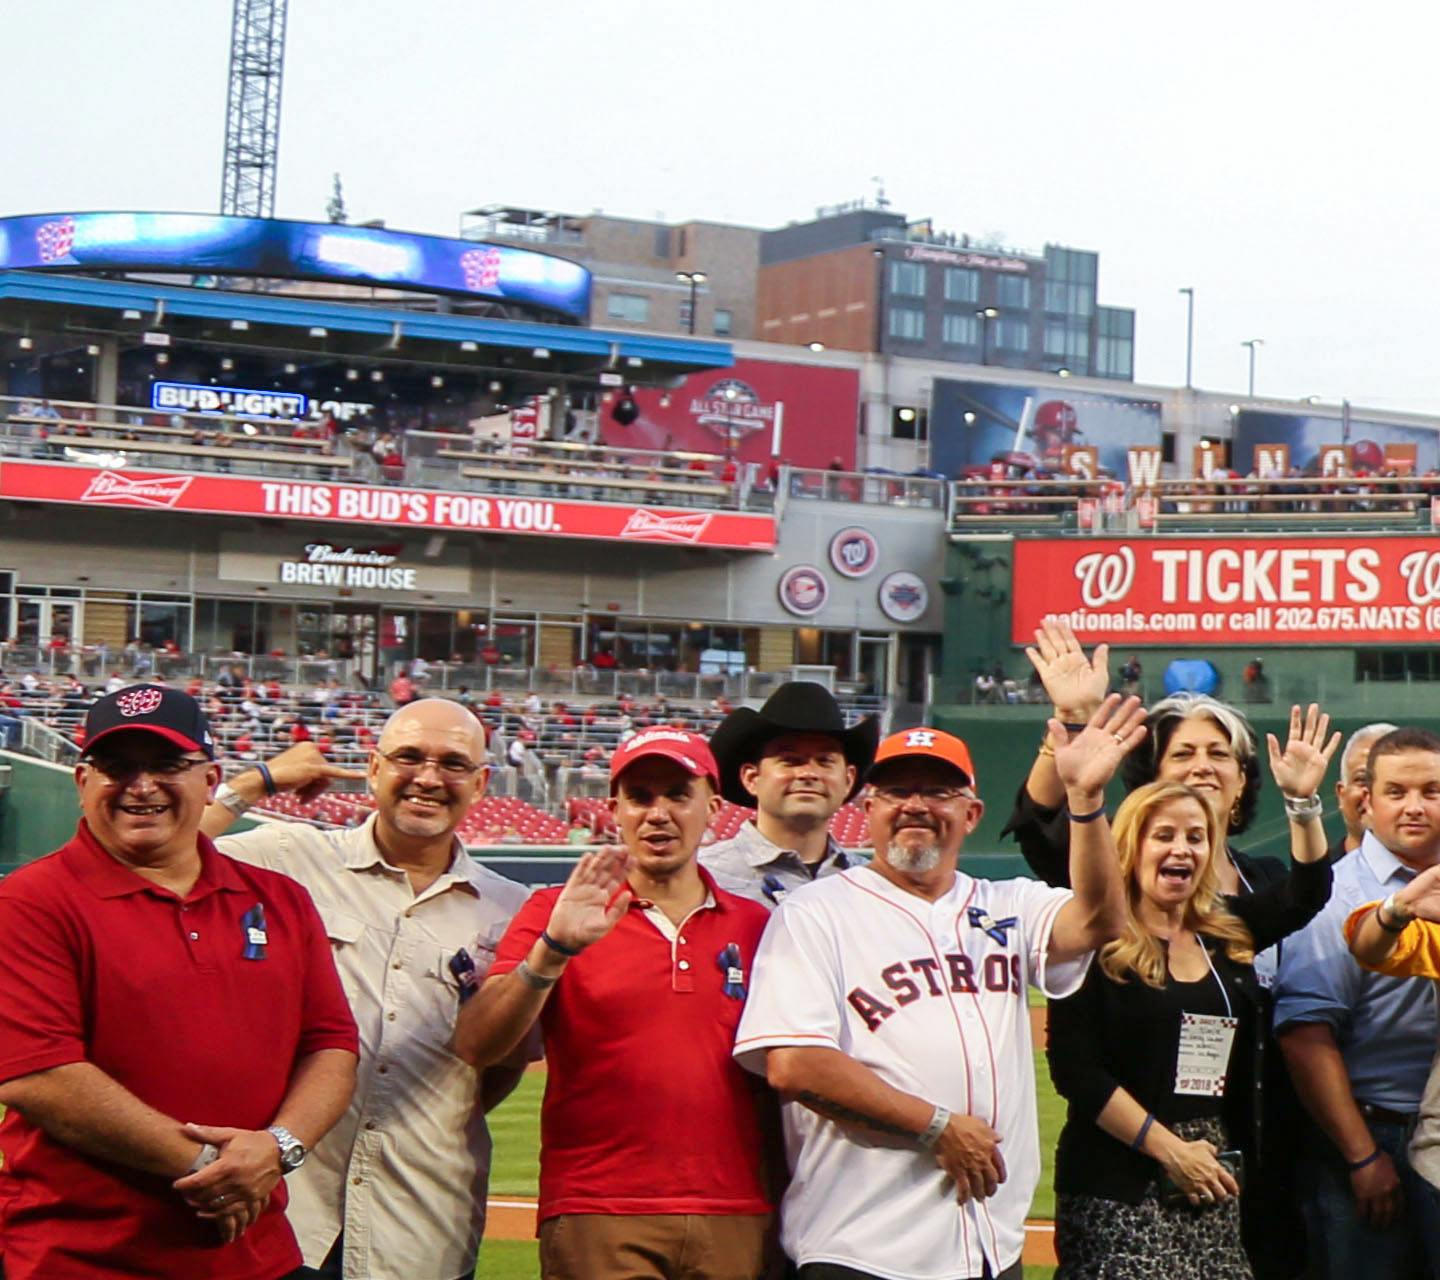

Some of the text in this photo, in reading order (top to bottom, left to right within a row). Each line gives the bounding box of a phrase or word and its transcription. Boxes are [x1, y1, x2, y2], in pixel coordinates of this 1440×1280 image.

[159, 386, 221, 410] BUD
[91, 476, 180, 498] Budweiser
[262, 482, 562, 532] THIS BUD'S FOR YOU.
[281, 562, 417, 590] BREW HOUSE
[1151, 548, 1381, 603] TICKETS
[1045, 607, 1196, 631] nationals.com
[1201, 612, 1224, 630] or
[1229, 607, 1270, 630] call
[1275, 606, 1420, 631] 202.675.NATS
[905, 731, 937, 748] H
[847, 953, 1022, 1032] ASTROS
